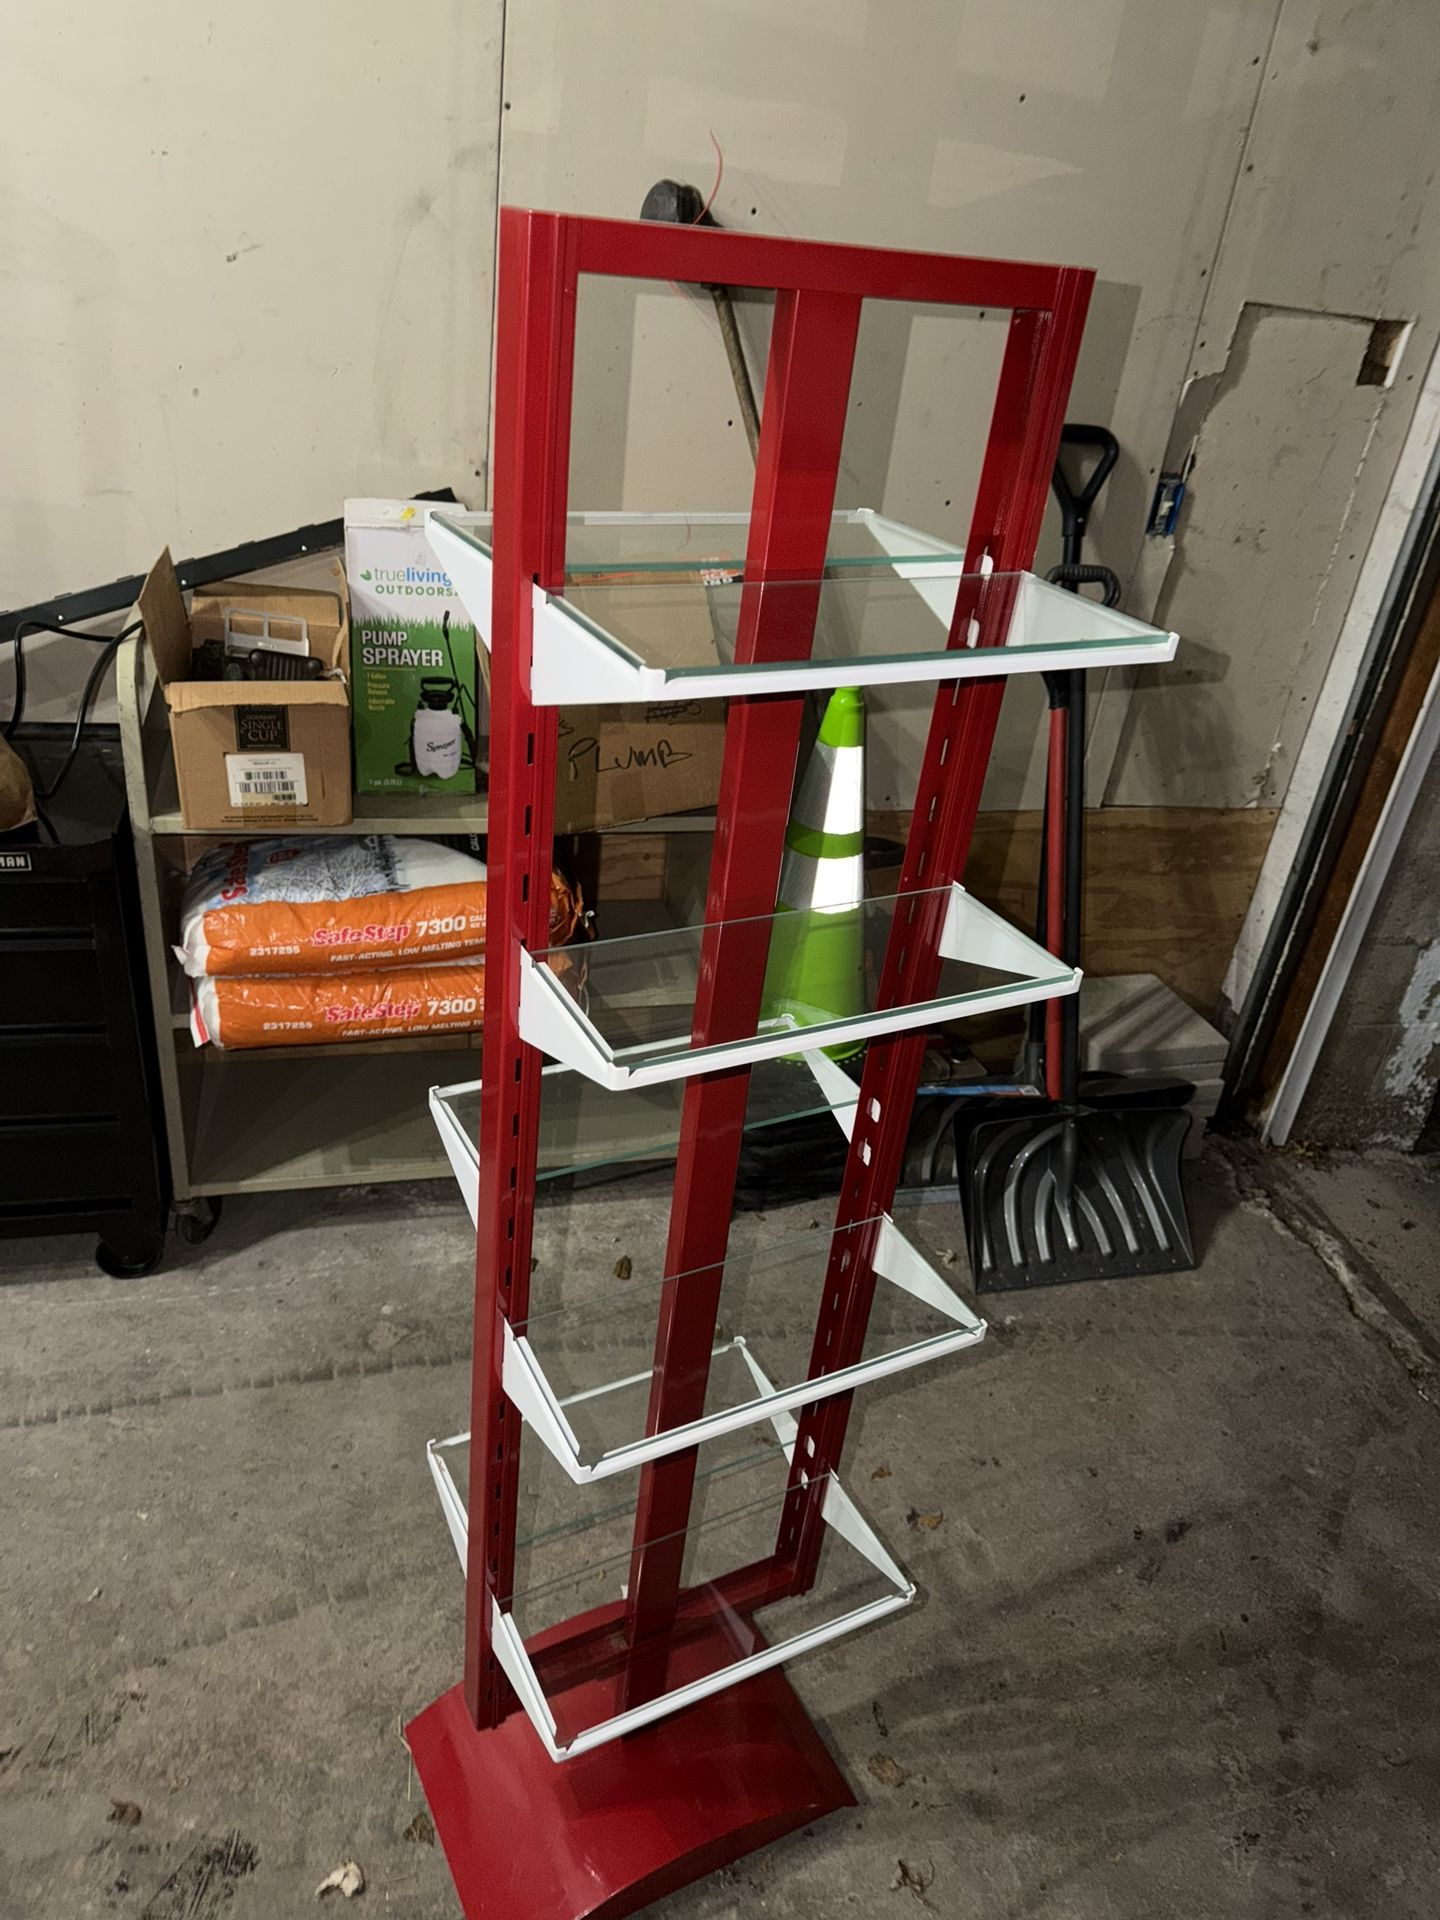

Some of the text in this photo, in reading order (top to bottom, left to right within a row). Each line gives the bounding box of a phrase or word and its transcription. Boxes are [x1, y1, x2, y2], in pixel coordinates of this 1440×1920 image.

[374, 567, 452, 587] trueliving
[362, 630, 407, 646] PUMP
[362, 647, 443, 667] SPRAYER
[241, 720, 284, 730] SINGLE
[248, 729, 278, 741] CUP
[312, 915, 466, 946] SafeStep 7300
[250, 945, 300, 956] 2317255
[398, 947, 419, 956] LOW
[422, 941, 461, 953] MELTING
[325, 1002, 421, 1023] SafeStep
[427, 998, 476, 1016] 7300
[263, 1021, 313, 1030] 2317255
[408, 1023, 430, 1032] LOW
[431, 1021, 470, 1030] MELTING
